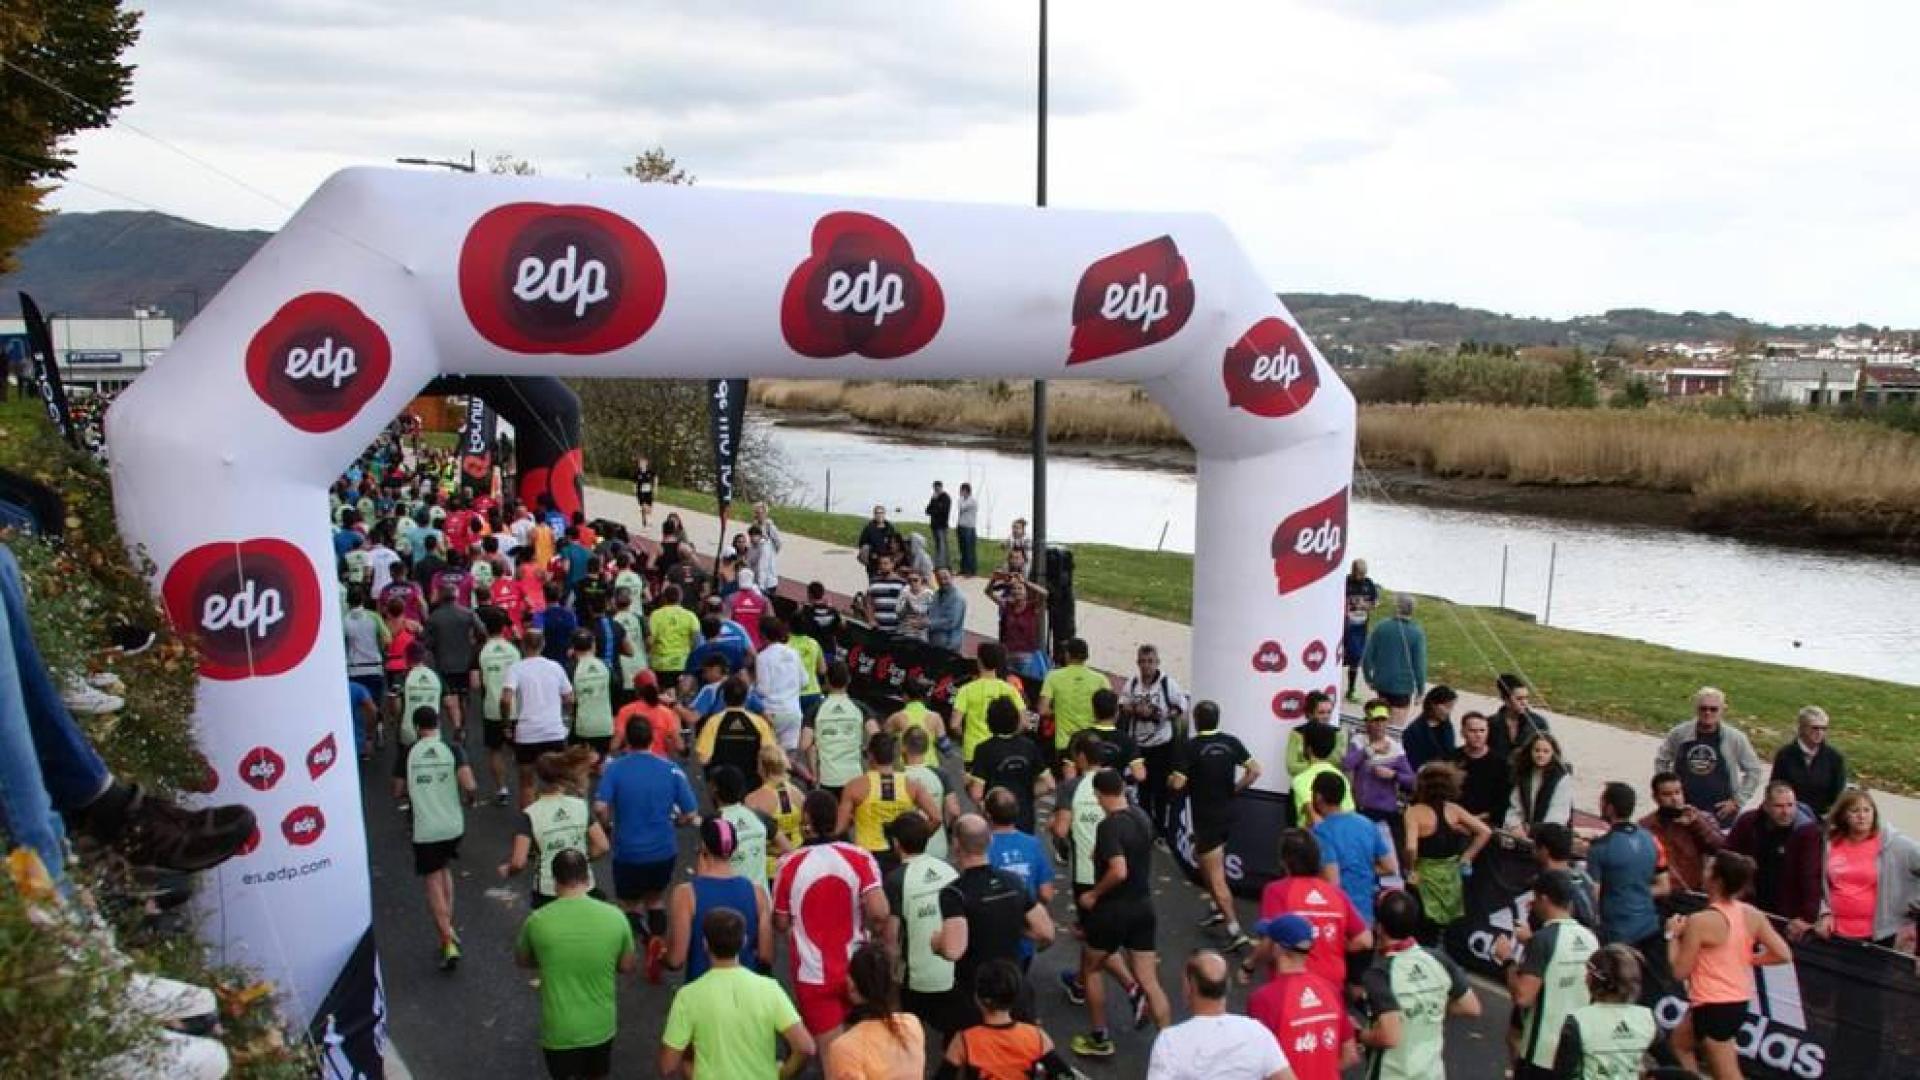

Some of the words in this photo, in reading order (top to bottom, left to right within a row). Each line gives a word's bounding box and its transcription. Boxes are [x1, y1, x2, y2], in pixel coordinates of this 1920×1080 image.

[513, 245, 609, 317] edp
[822, 259, 905, 326] edp
[1100, 272, 1169, 332] edp
[284, 337, 358, 387] edp
[1251, 345, 1301, 390] edp
[1294, 519, 1341, 561] edp
[201, 579, 285, 638] edp
[250, 759, 276, 779] edp
[292, 815, 317, 833] edp
[1654, 995, 1826, 1079] adas
